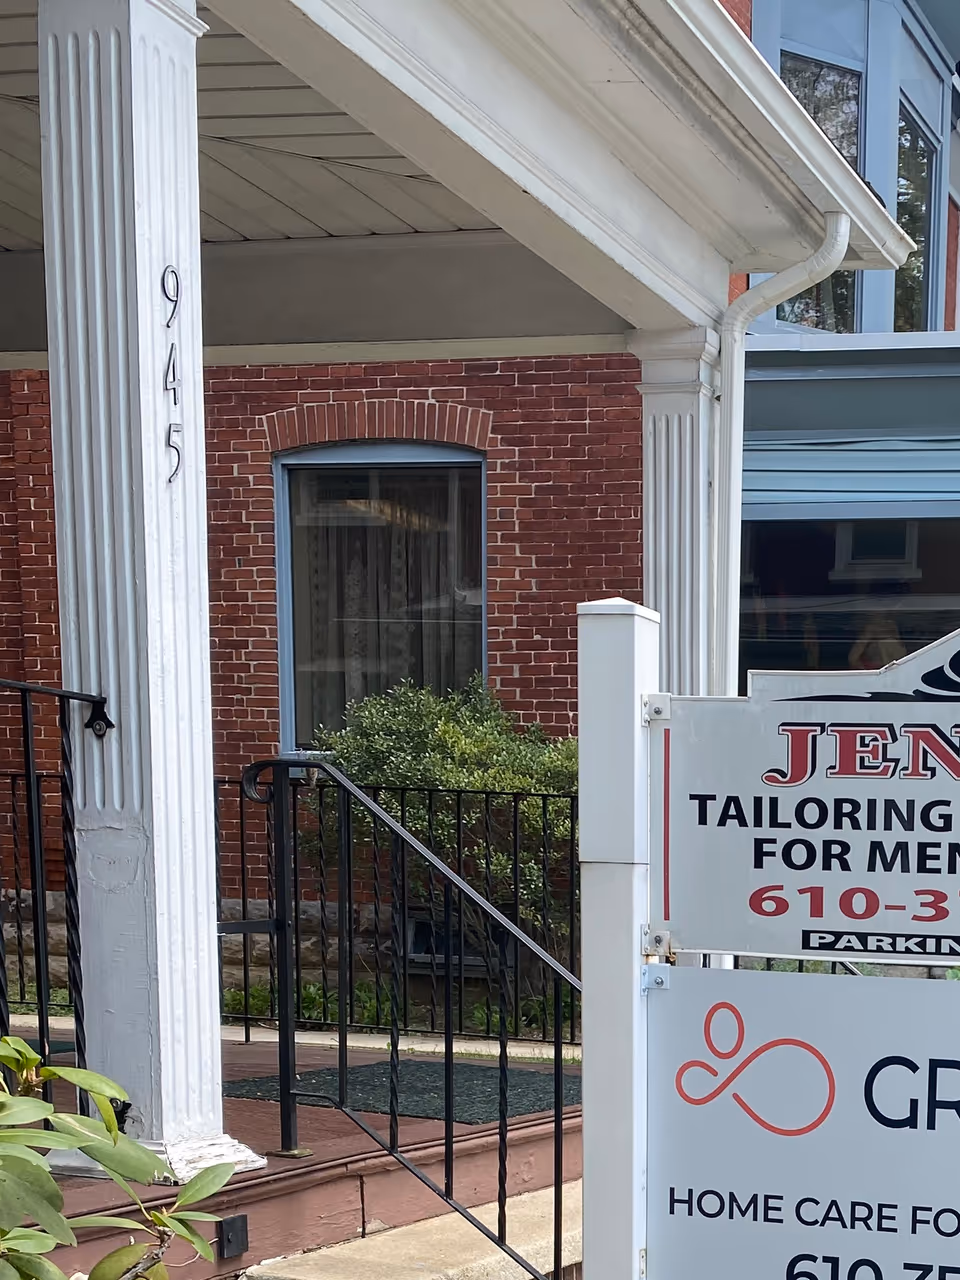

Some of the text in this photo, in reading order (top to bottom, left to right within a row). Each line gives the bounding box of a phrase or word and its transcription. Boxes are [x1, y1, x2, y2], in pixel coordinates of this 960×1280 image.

[161, 264, 183, 484] 945
[688, 793, 953, 833] TAILORING
[753, 837, 852, 872] FOR
[667, 1186, 785, 1225] HOME
[794, 1196, 899, 1234] CARE
